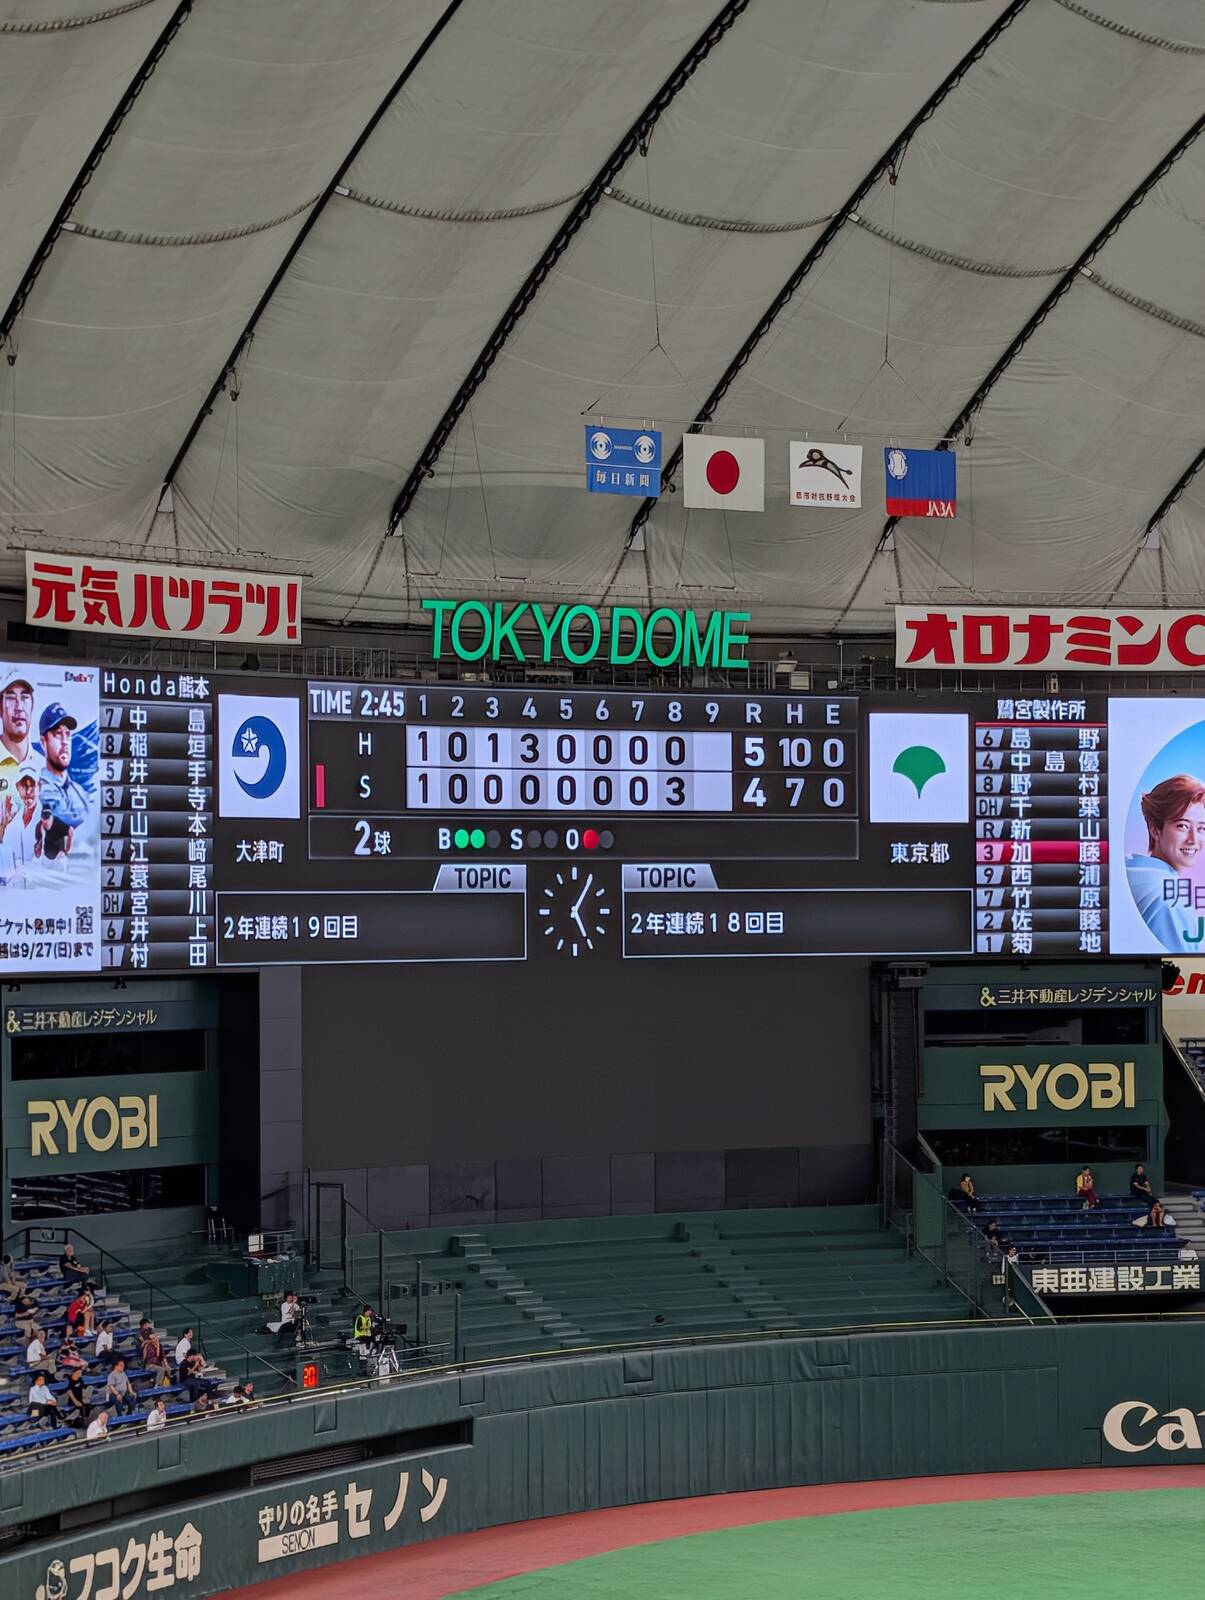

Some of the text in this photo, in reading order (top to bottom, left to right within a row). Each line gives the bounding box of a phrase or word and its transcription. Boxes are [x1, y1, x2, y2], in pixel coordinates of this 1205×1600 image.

[32, 563, 297, 639] 元気ハツラツ!
[421, 599, 752, 669] TOKYO DOME
[905, 613, 1205, 667] オロナミンC
[310, 690, 405, 717] TIME 2:45
[419, 695, 841, 725] 1 2 3 4 5 6 7 8 9 R H E
[997, 699, 1086, 720] 鷺宮製作所
[105, 709, 115, 728] 7
[105, 735, 115, 753] 8
[983, 731, 994, 746] 6
[358, 731, 844, 768] H 1 0 1 3 0 0 0 0 5 10 0
[983, 753, 994, 768] 4
[105, 763, 115, 781] 5
[359, 773, 844, 807] S 1 0 0 0 0 0 0 3 4 7 0
[983, 776, 994, 791] 8
[105, 789, 115, 807] 3
[979, 800, 998, 815] DH
[105, 816, 115, 834] 9
[983, 823, 994, 838] R
[439, 829, 451, 850] B
[510, 829, 523, 850] S
[105, 842, 115, 859] 4
[236, 839, 284, 864] 大津町
[891, 842, 950, 864] 東京都
[983, 846, 994, 860] 3
[105, 868, 115, 885] 2
[454, 868, 512, 889] TOPIC
[637, 867, 696, 888] TOPIC
[983, 868, 994, 883] 9
[103, 895, 120, 912] DH
[983, 891, 994, 906] 7
[105, 920, 115, 938] 6
[983, 913, 994, 928] 2
[985, 936, 992, 951] 1
[108, 946, 113, 964] 1
[980, 1062, 1135, 1111] RYOBI
[27, 1094, 158, 1156] RYOBI
[1032, 1264, 1200, 1293] 東亜建設工業
[1103, 1400, 1205, 1453] Ca
[258, 1490, 338, 1536] 守りの名手
[282, 1528, 315, 1555] SENON
[70, 1522, 202, 1600] フコク生命
